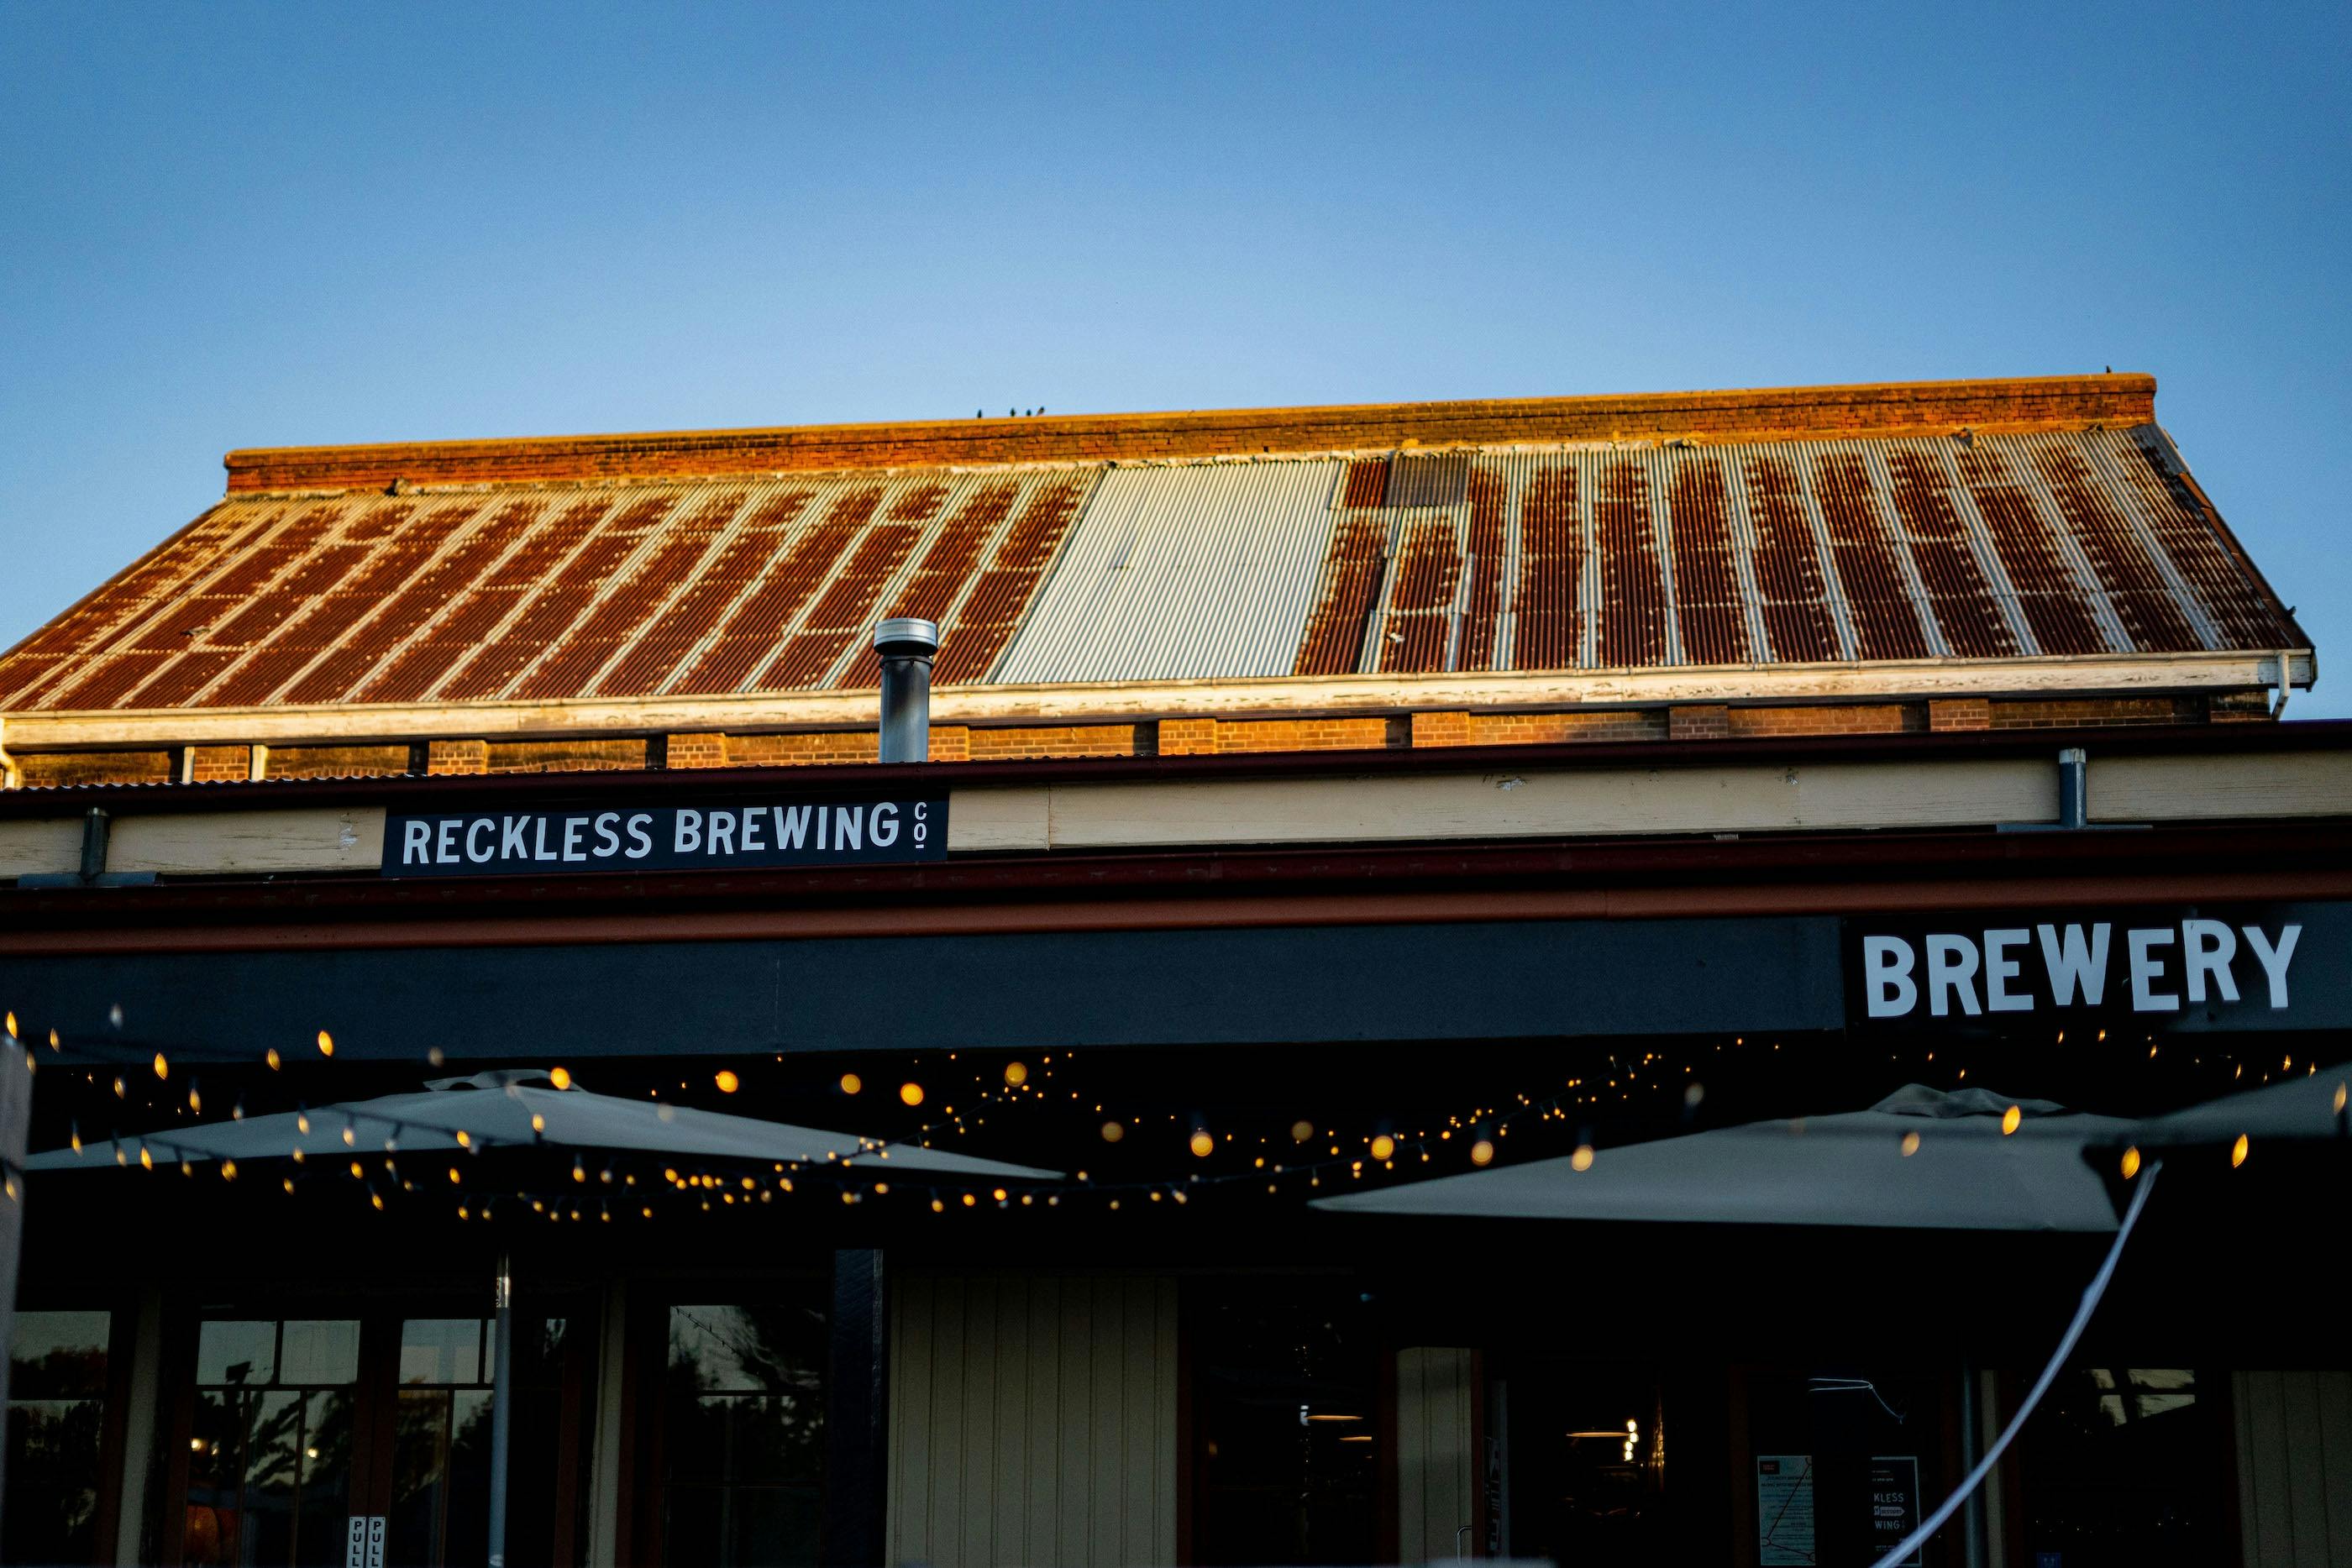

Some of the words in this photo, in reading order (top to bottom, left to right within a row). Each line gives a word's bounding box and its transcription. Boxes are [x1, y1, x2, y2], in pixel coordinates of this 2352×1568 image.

[402, 811, 654, 864] RECKLESS
[674, 801, 900, 855] BREWING
[913, 801, 927, 849] CO
[1863, 919, 2302, 1018] BREWERY
[352, 1521, 362, 1567] PULL
[371, 1521, 381, 1567] PULL
